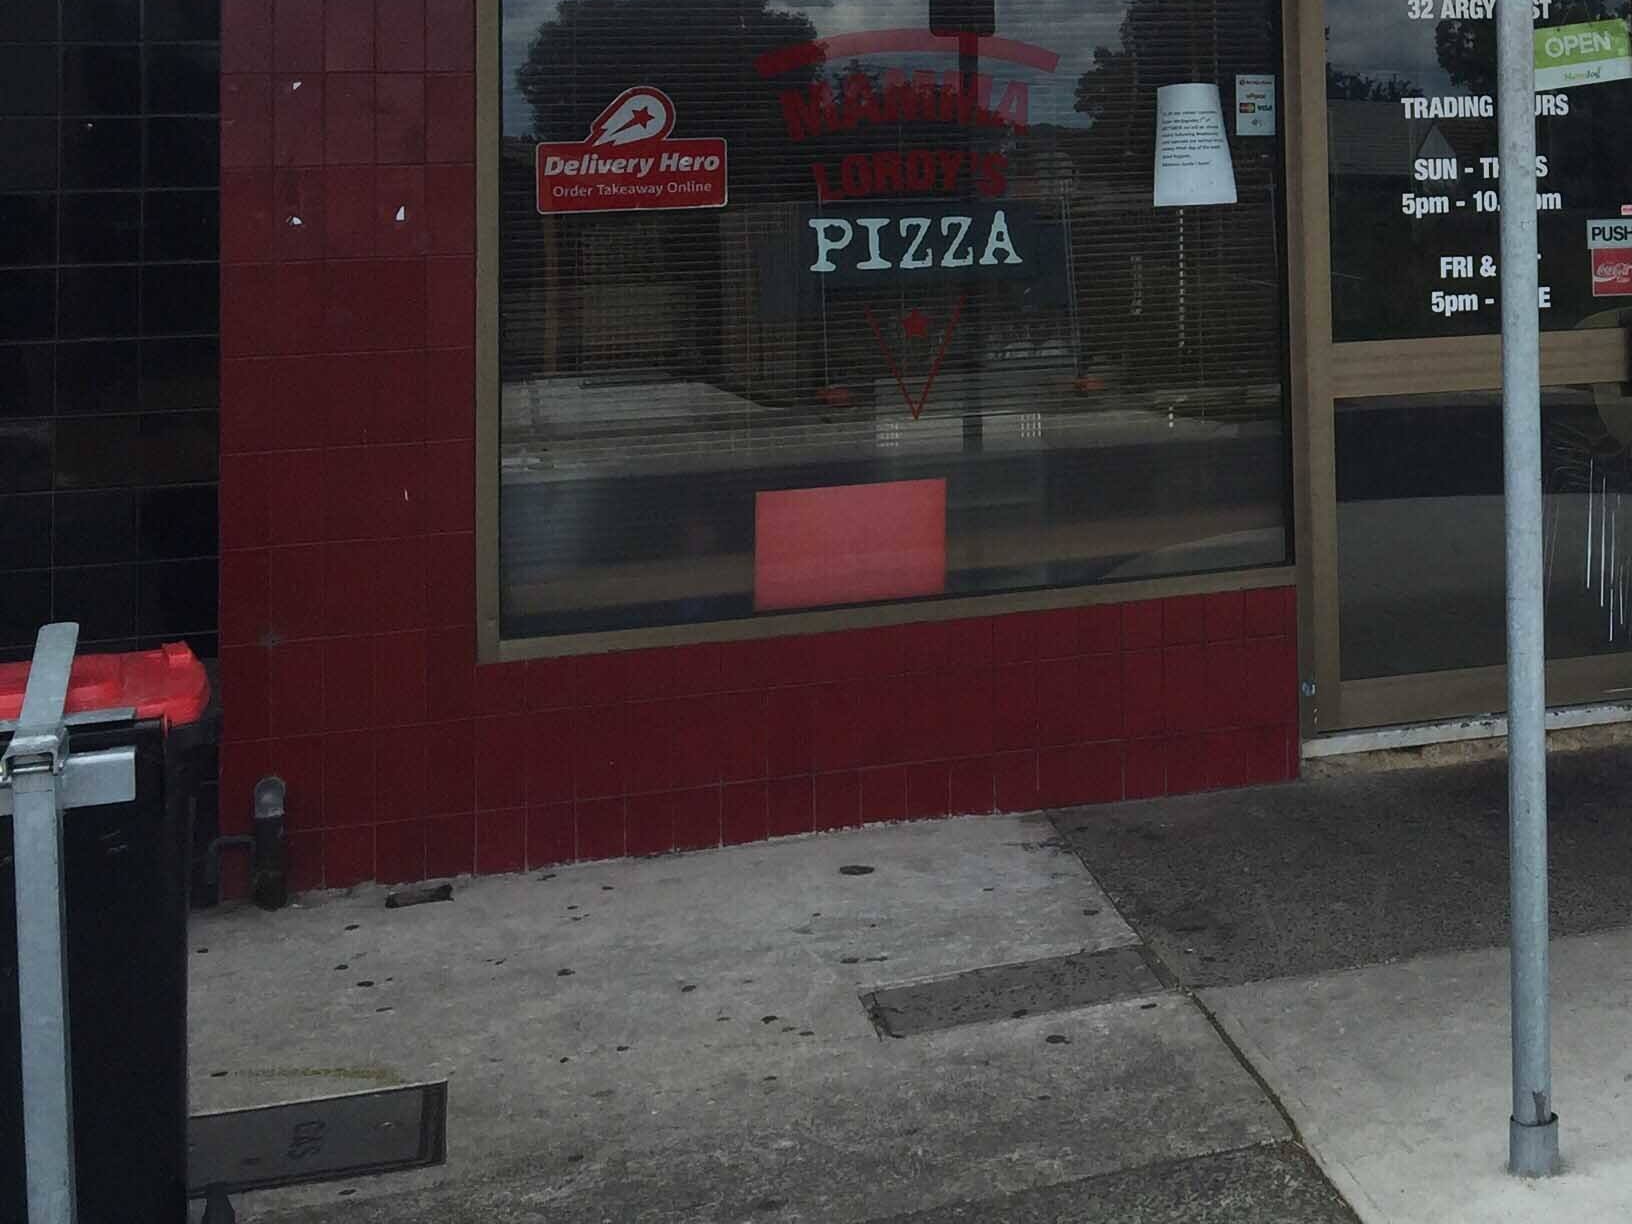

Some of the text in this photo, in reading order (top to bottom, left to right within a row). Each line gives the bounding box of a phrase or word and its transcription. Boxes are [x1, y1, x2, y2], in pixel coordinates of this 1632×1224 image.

[1545, 30, 1611, 58] OPEN
[779, 67, 1030, 141] MAMMA
[1401, 94, 1569, 119] TRADING URS
[544, 152, 720, 177] Delivery Hero
[811, 149, 1008, 200] LORDY'S
[1414, 157, 1457, 180] SUN
[552, 180, 712, 197] Order Takeaway Online
[1402, 193, 1449, 218] 5pm
[808, 210, 1023, 272] PIZZA
[1440, 256, 1496, 278] FRI &
[1431, 292, 1478, 316] 5pm
